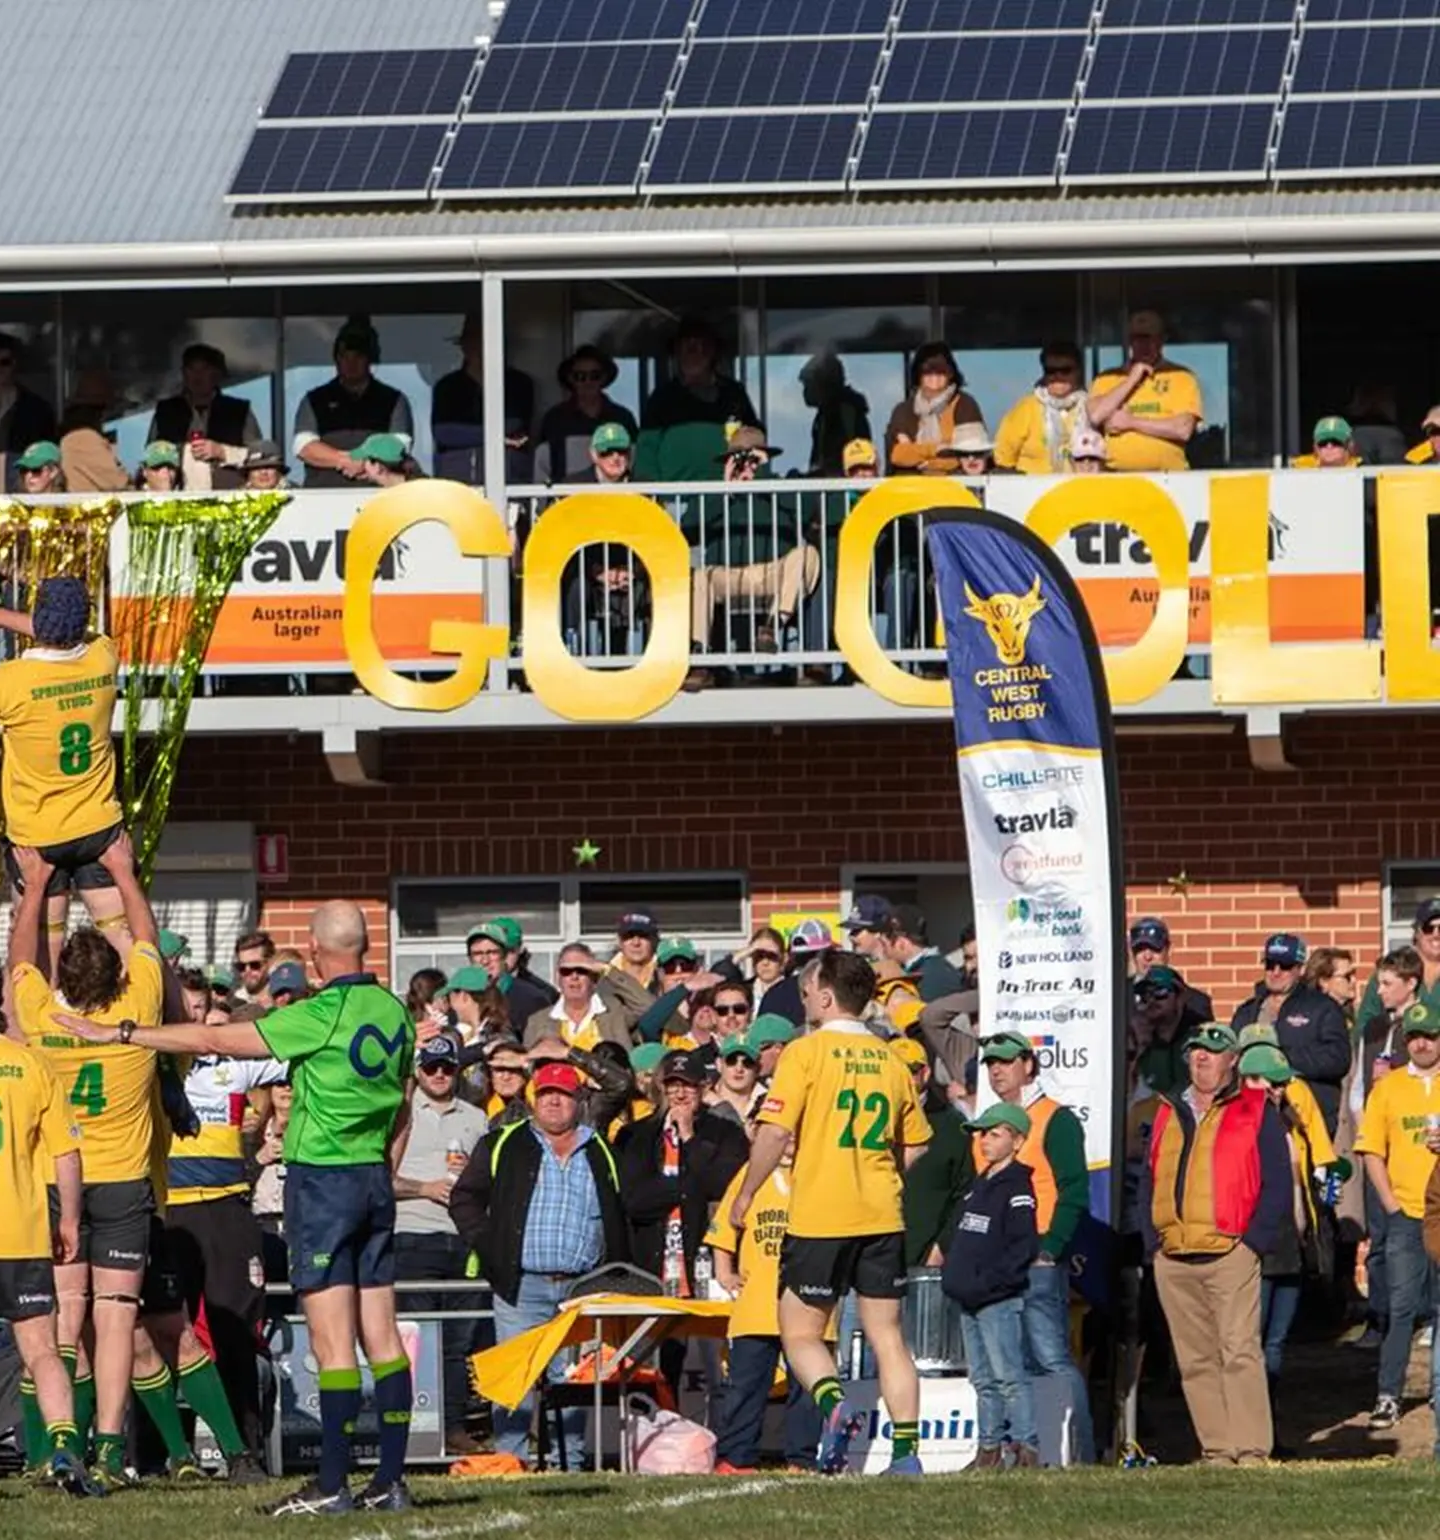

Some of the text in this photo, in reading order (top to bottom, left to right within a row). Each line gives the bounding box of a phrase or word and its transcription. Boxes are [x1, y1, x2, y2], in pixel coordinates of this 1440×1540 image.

[343, 479, 691, 721] GO
[251, 606, 343, 621] Australian
[274, 622, 322, 641] lager
[974, 663, 1053, 687] CENTRAL
[990, 684, 1041, 703] WEST
[988, 702, 1048, 723] RUGBY
[59, 721, 93, 776] 8
[994, 806, 1074, 834] travla
[1015, 951, 1094, 964] NEW HOLLAND
[1069, 977, 1096, 994] Ag
[70, 1062, 107, 1116] 4
[836, 1089, 890, 1151] 22
